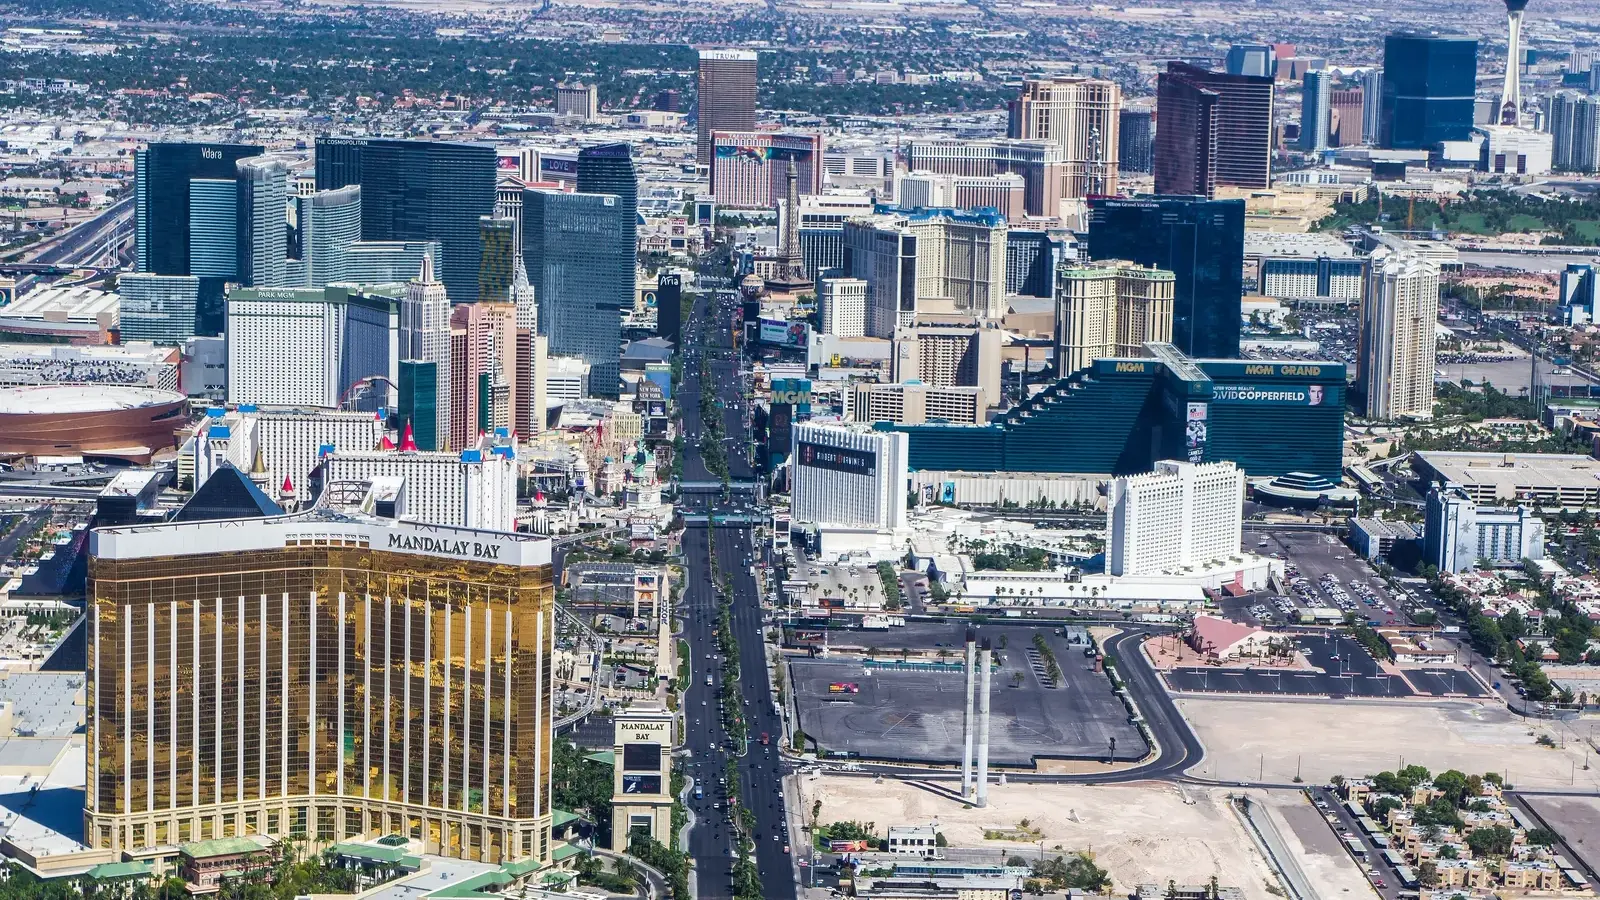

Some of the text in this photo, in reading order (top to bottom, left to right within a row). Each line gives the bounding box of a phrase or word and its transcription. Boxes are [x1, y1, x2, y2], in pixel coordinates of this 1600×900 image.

[201, 147, 222, 160] Vdara
[549, 160, 569, 171] LOVE
[660, 276, 679, 286] Aria
[258, 291, 275, 299] PARK
[1115, 362, 1145, 373] MGM
[1245, 364, 1321, 376] MGM GRAND
[770, 390, 811, 404] MGM
[388, 533, 501, 559] MANDALAY BAY
